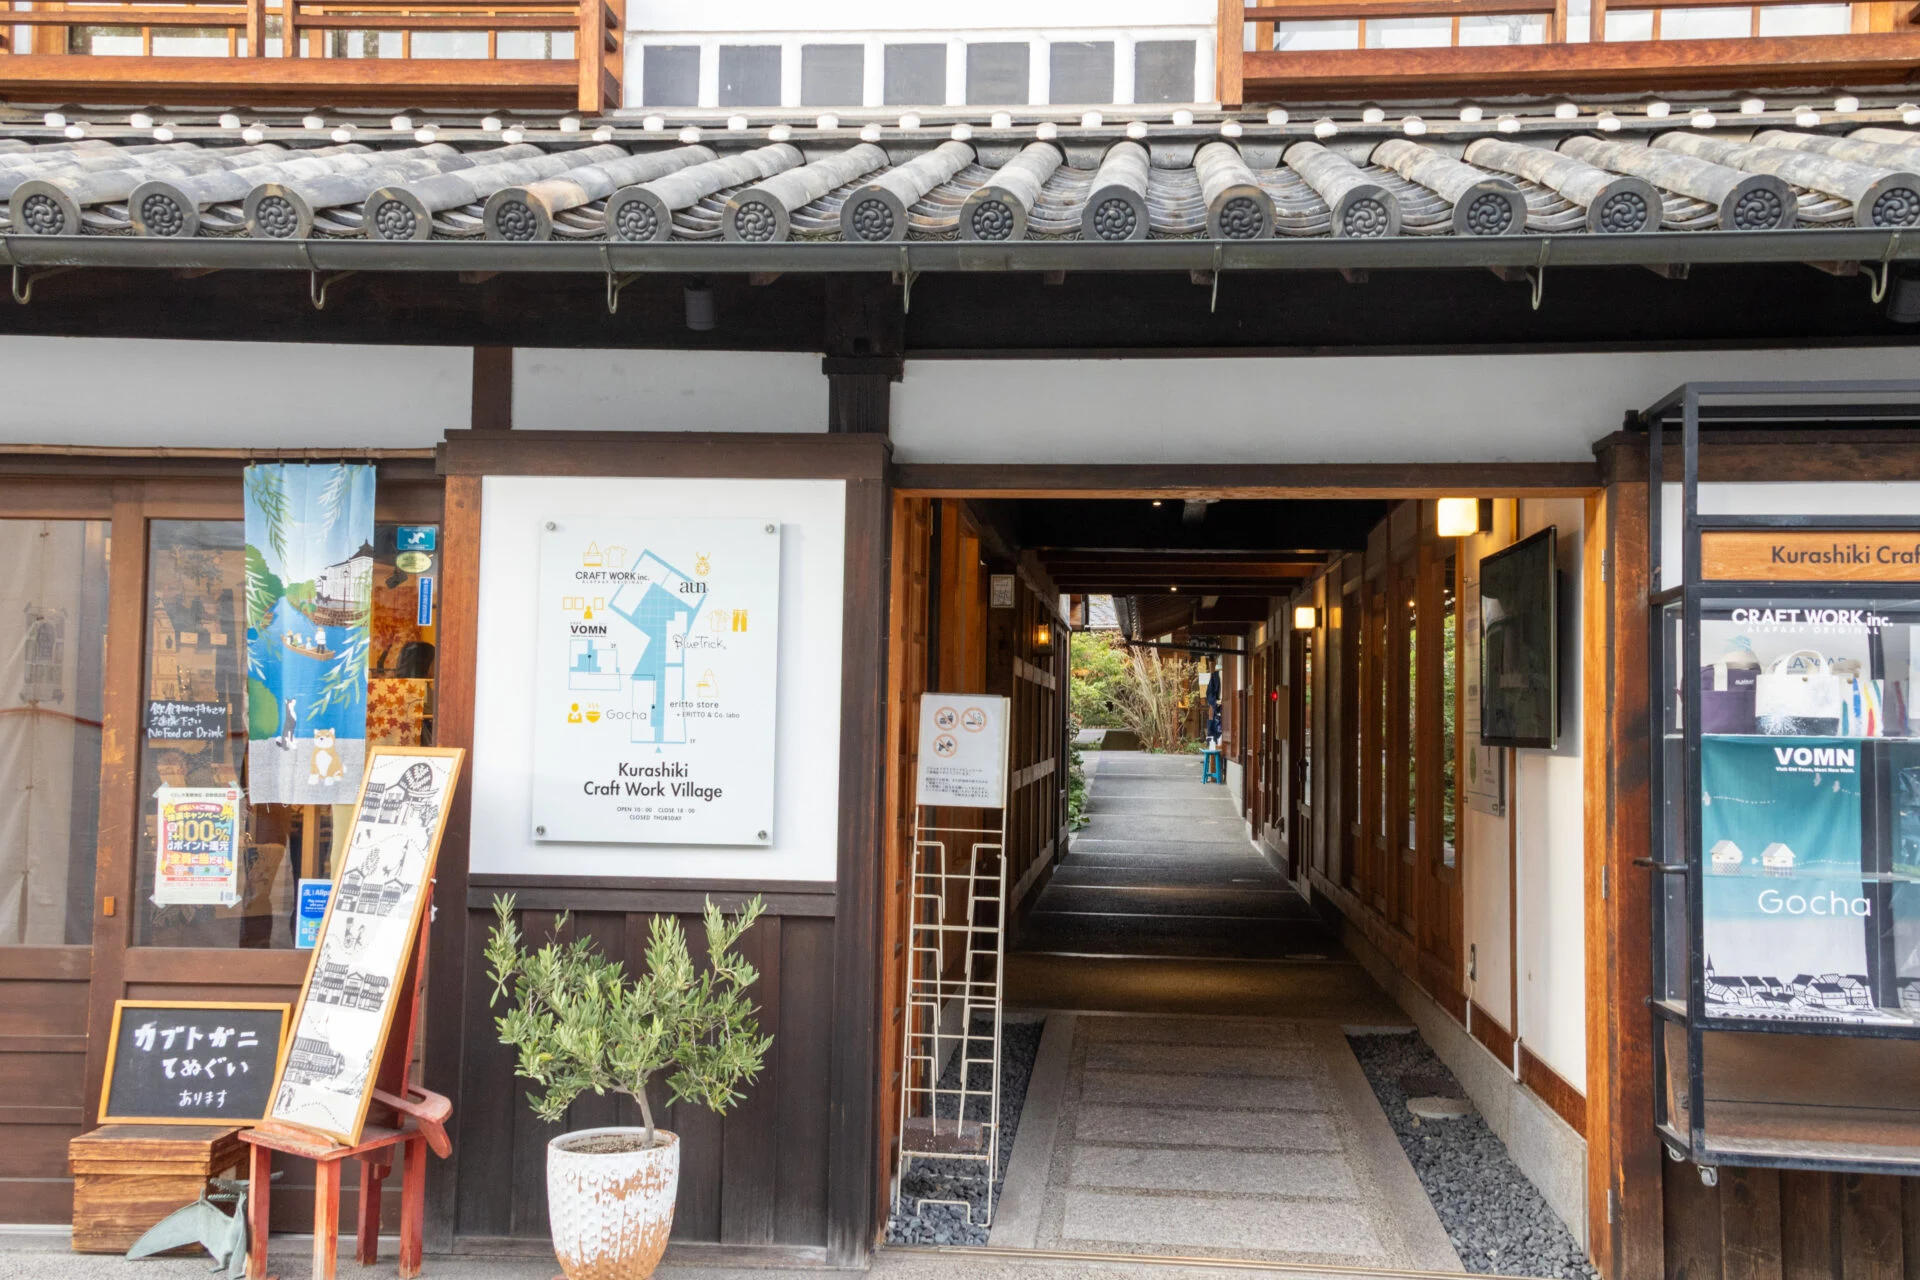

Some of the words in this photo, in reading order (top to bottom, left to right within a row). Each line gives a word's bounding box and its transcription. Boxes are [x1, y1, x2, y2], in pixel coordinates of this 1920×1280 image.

[1771, 544, 1871, 564] Kurashiki
[575, 571, 607, 580] CRAFT
[609, 571, 636, 581] WORK
[1731, 608, 1800, 625] CRAFT
[1804, 609, 1864, 627] WORK
[1866, 612, 1894, 627] inc.
[570, 625, 607, 635] VOMN
[1814, 626, 1879, 635] ORIGINAL
[606, 709, 647, 720] Gocha
[669, 701, 693, 709] eritto
[148, 728, 163, 738] No
[163, 727, 181, 738] Food
[196, 725, 224, 738] Drink
[1774, 747, 1855, 767] VOMN
[619, 761, 689, 778] Kurashiki
[584, 780, 621, 796] Craft
[625, 781, 665, 797] Work
[671, 781, 722, 802] Village
[1758, 889, 1871, 917] Gocha
[134, 1021, 259, 1052] カブトガニ
[162, 1057, 249, 1079] てぬぐい
[179, 1089, 228, 1108] あります
